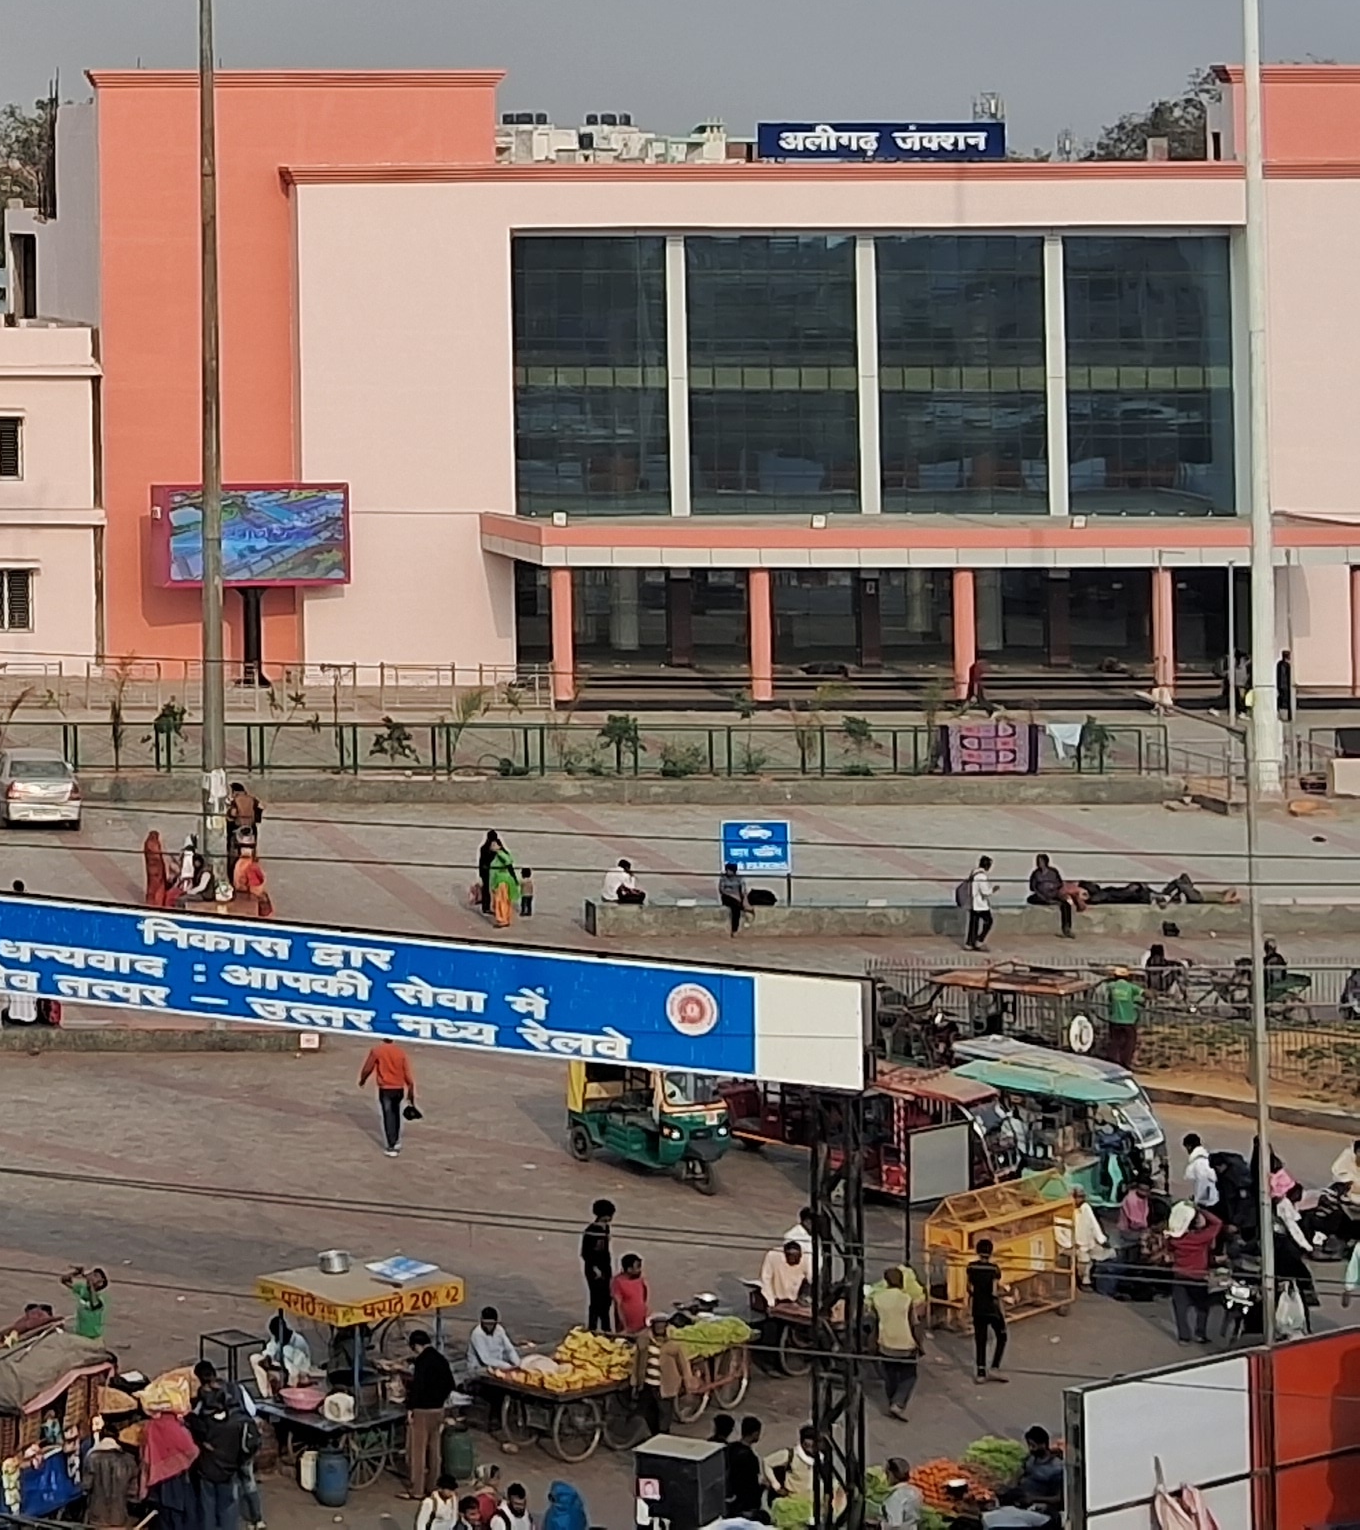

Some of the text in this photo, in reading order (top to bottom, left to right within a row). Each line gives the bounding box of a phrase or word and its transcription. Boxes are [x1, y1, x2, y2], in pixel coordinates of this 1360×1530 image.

[778, 123, 988, 156] अलीगढ़ जंक्शन
[137, 919, 396, 971] निकास द्वार
[53, 973, 172, 1008] तत्पर
[246, 996, 378, 1032] उत्तर
[391, 1012, 500, 1047] मध्य
[516, 1019, 633, 1060] रेलवे
[220, 964, 372, 1003] आपकी
[387, 975, 488, 1014] सेवा
[505, 985, 552, 1022] में
